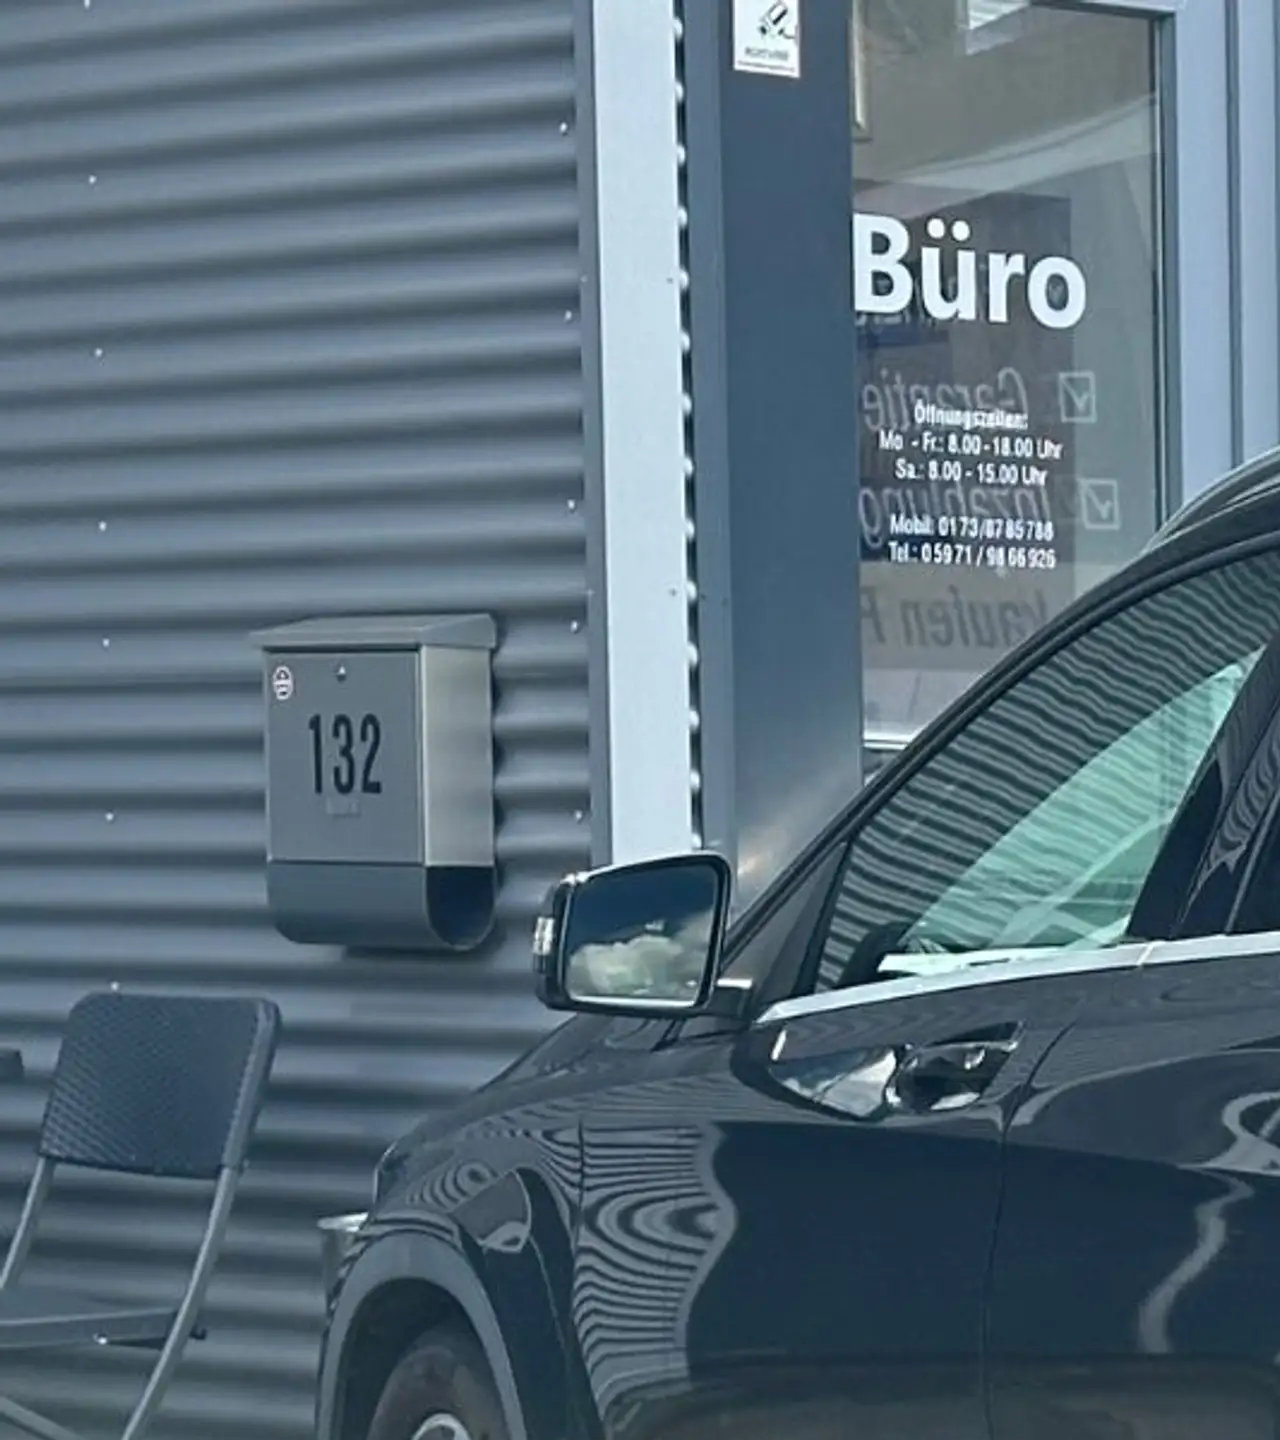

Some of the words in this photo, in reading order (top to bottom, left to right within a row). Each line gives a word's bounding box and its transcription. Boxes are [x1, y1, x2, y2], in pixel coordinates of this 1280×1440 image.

[853, 213, 1086, 329] Büro
[928, 460, 962, 482] 8.00
[977, 462, 1019, 485] 15.00
[1022, 464, 1048, 487] Uhr
[1036, 437, 1064, 460] Uhr
[308, 713, 382, 795] 132
